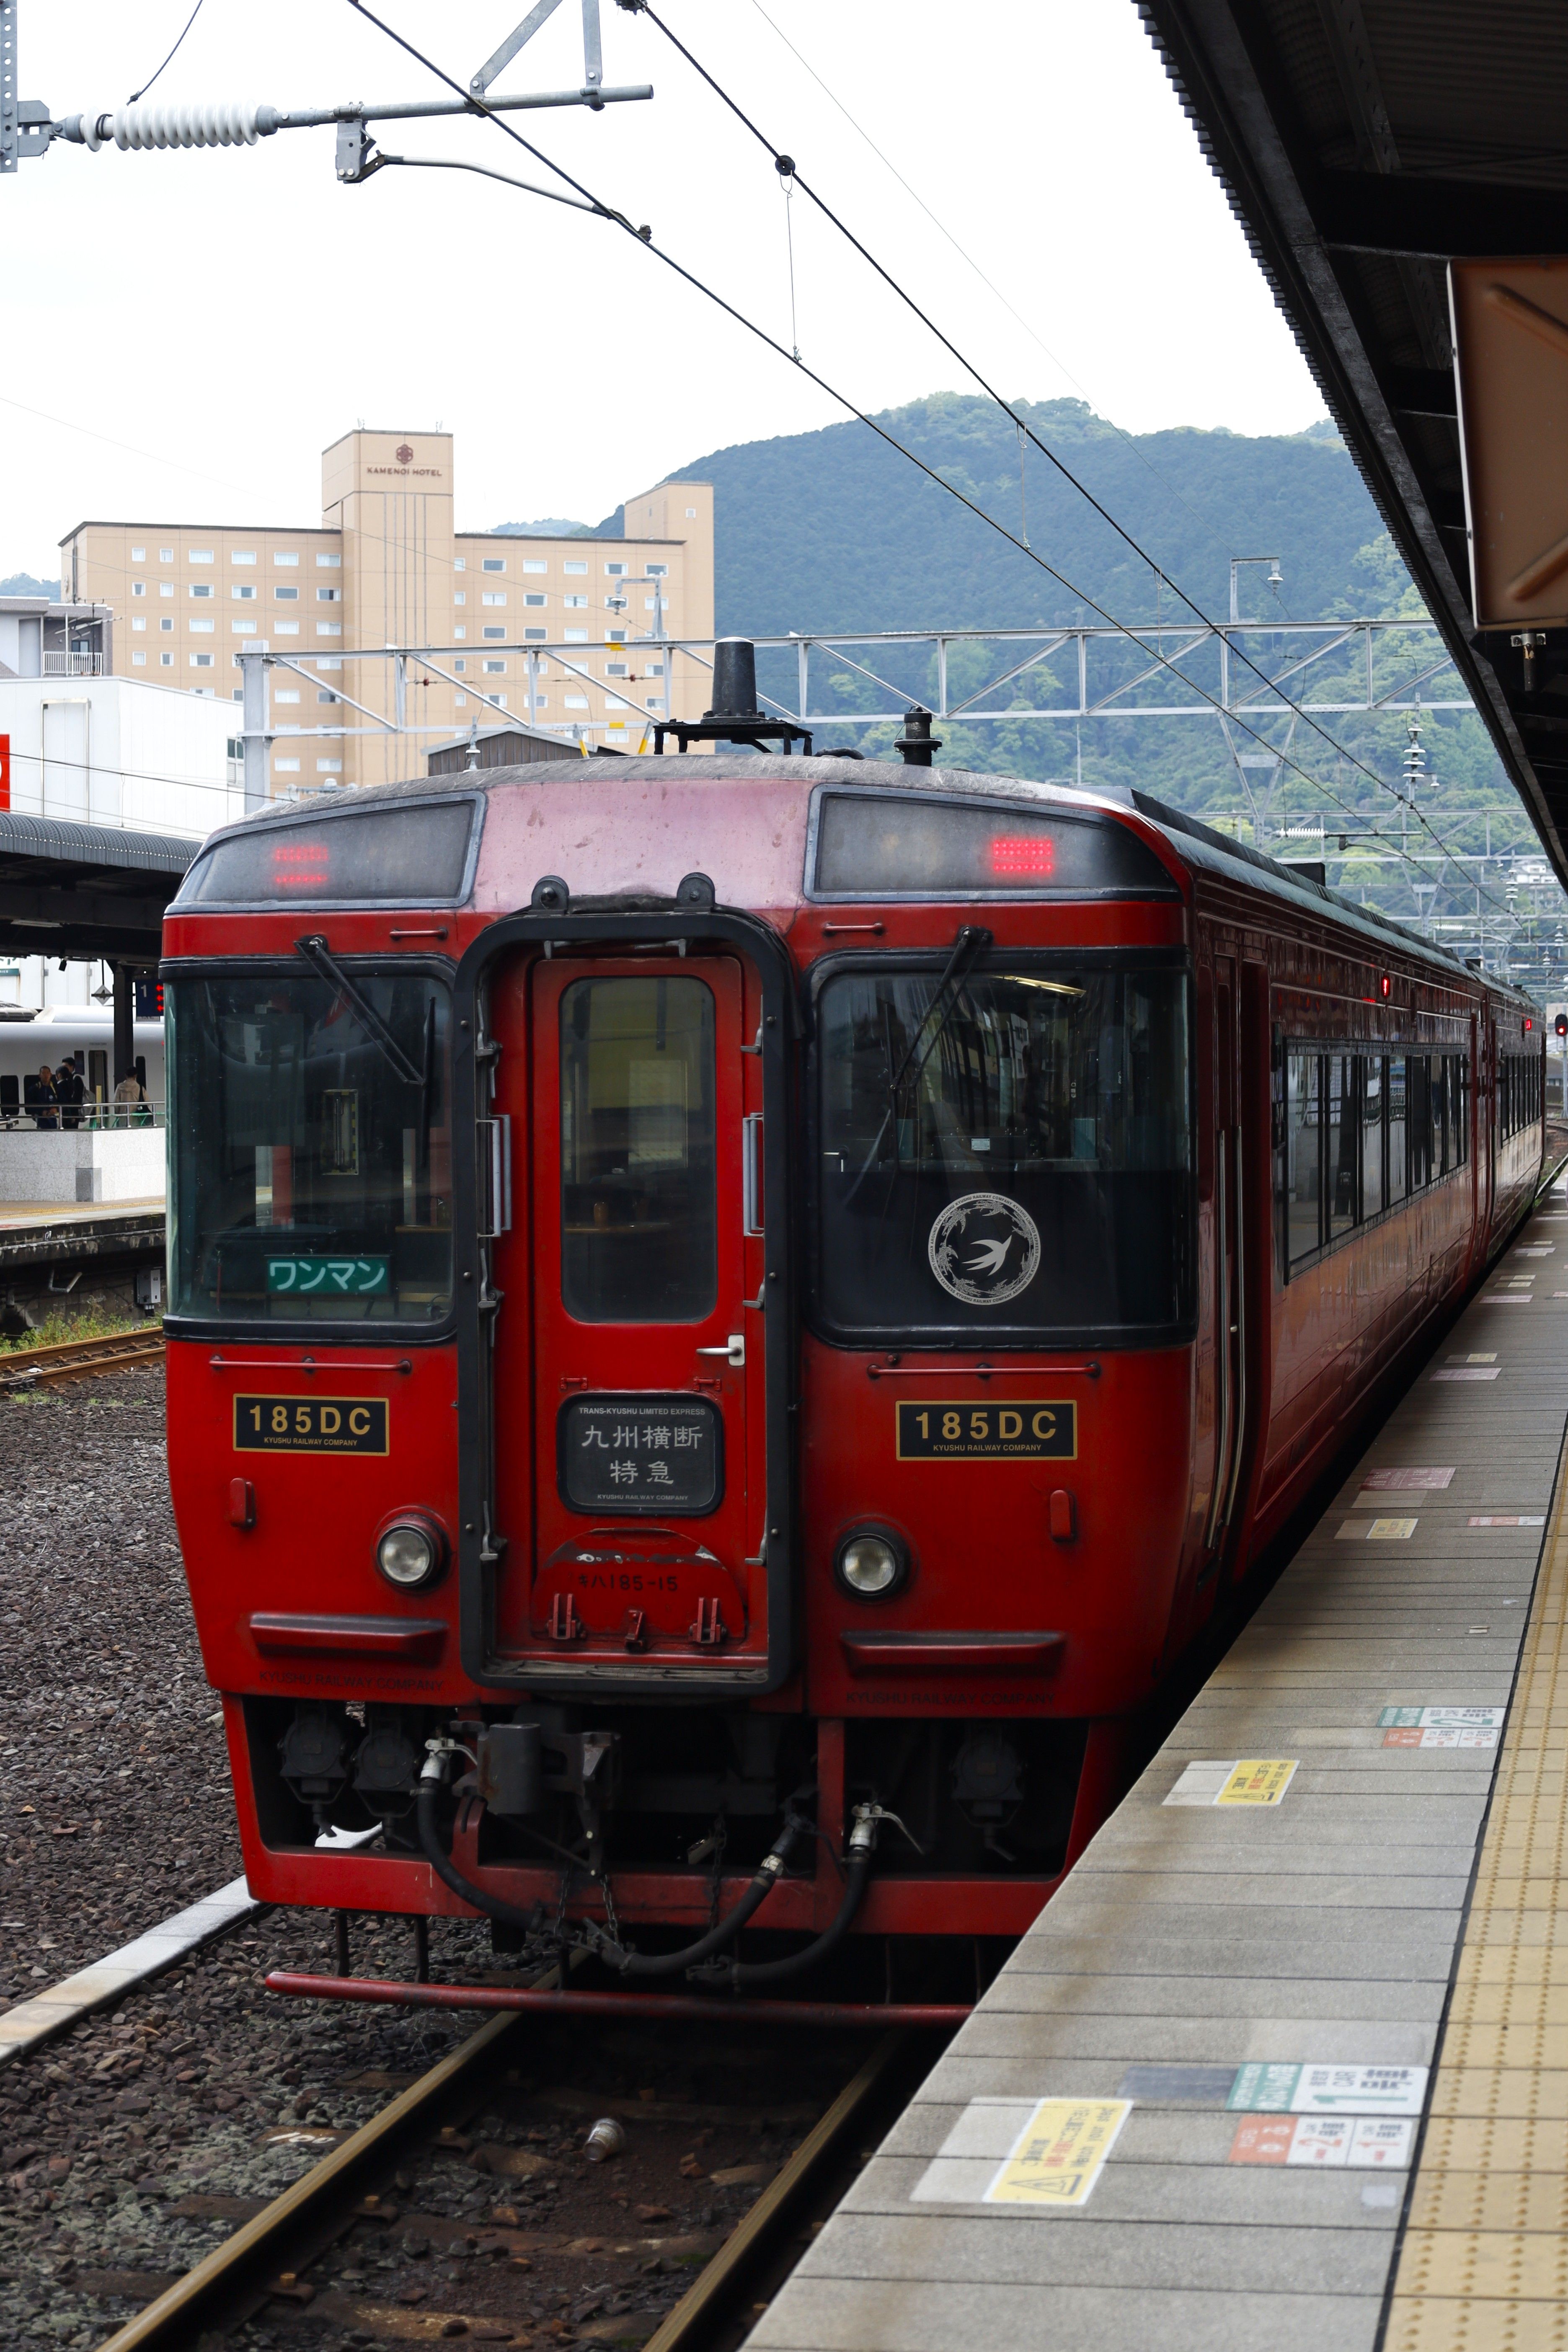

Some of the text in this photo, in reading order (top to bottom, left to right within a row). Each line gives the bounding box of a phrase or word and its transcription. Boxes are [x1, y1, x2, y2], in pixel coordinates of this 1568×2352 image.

[141, 985, 147, 998] 1
[941, 1205, 955, 1219] KYUSHU
[956, 1197, 972, 1205] KYUSHU
[992, 1195, 1013, 1205] COMPANY
[1013, 1204, 1027, 1218] KYUSHU
[1026, 1217, 1036, 1233] LIMITED
[270, 1261, 385, 1290] ワンマン
[933, 1263, 942, 1279] LIMITED
[940, 1279, 955, 1293] EXPRESS
[956, 1292, 972, 1301] KYUSHU
[992, 1293, 1012, 1302] COMPANY
[1013, 1281, 1027, 1294] AROUND
[250, 1405, 370, 1435] 185DC
[916, 1411, 1056, 1439] 185DC
[581, 1425, 703, 1449] 九州横断
[610, 1460, 674, 1484] 特急
[579, 1574, 677, 1591] キハ185-15
[259, 1671, 443, 1691] KYUSHU RAILWAY COMPANY
[846, 1692, 1055, 1705] KYUSHU RAILWAY COMPANY
[1332, 2071, 1356, 2087] CAR
